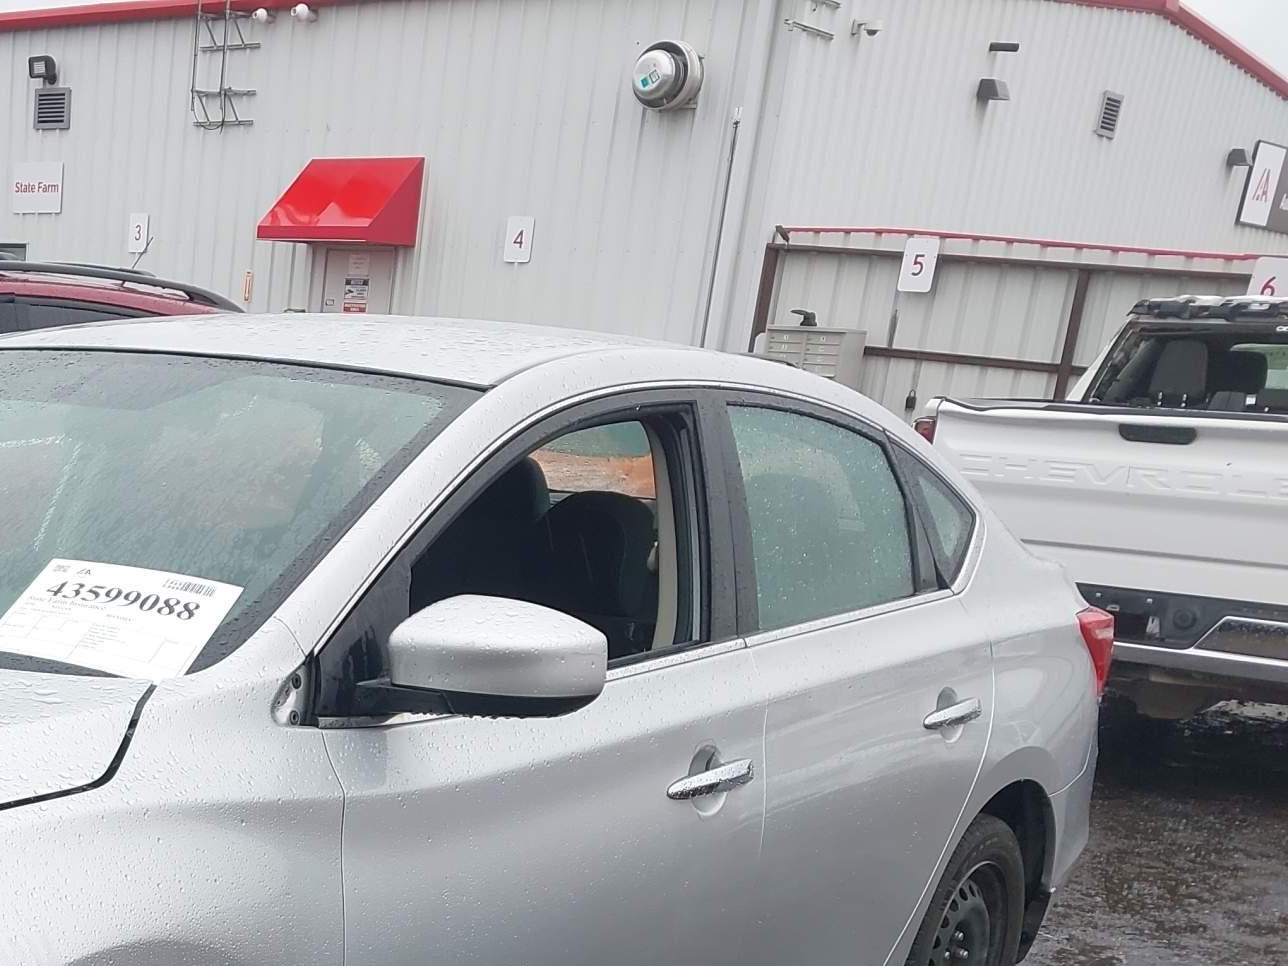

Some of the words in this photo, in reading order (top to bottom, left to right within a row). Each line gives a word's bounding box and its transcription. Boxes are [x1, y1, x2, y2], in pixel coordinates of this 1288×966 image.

[14, 181, 36, 194] State
[37, 181, 59, 193] Farm
[134, 224, 142, 241] 3
[513, 229, 524, 248] 4
[911, 254, 925, 276] 5
[1259, 276, 1276, 297] 6
[45, 580, 201, 621] 43599088
